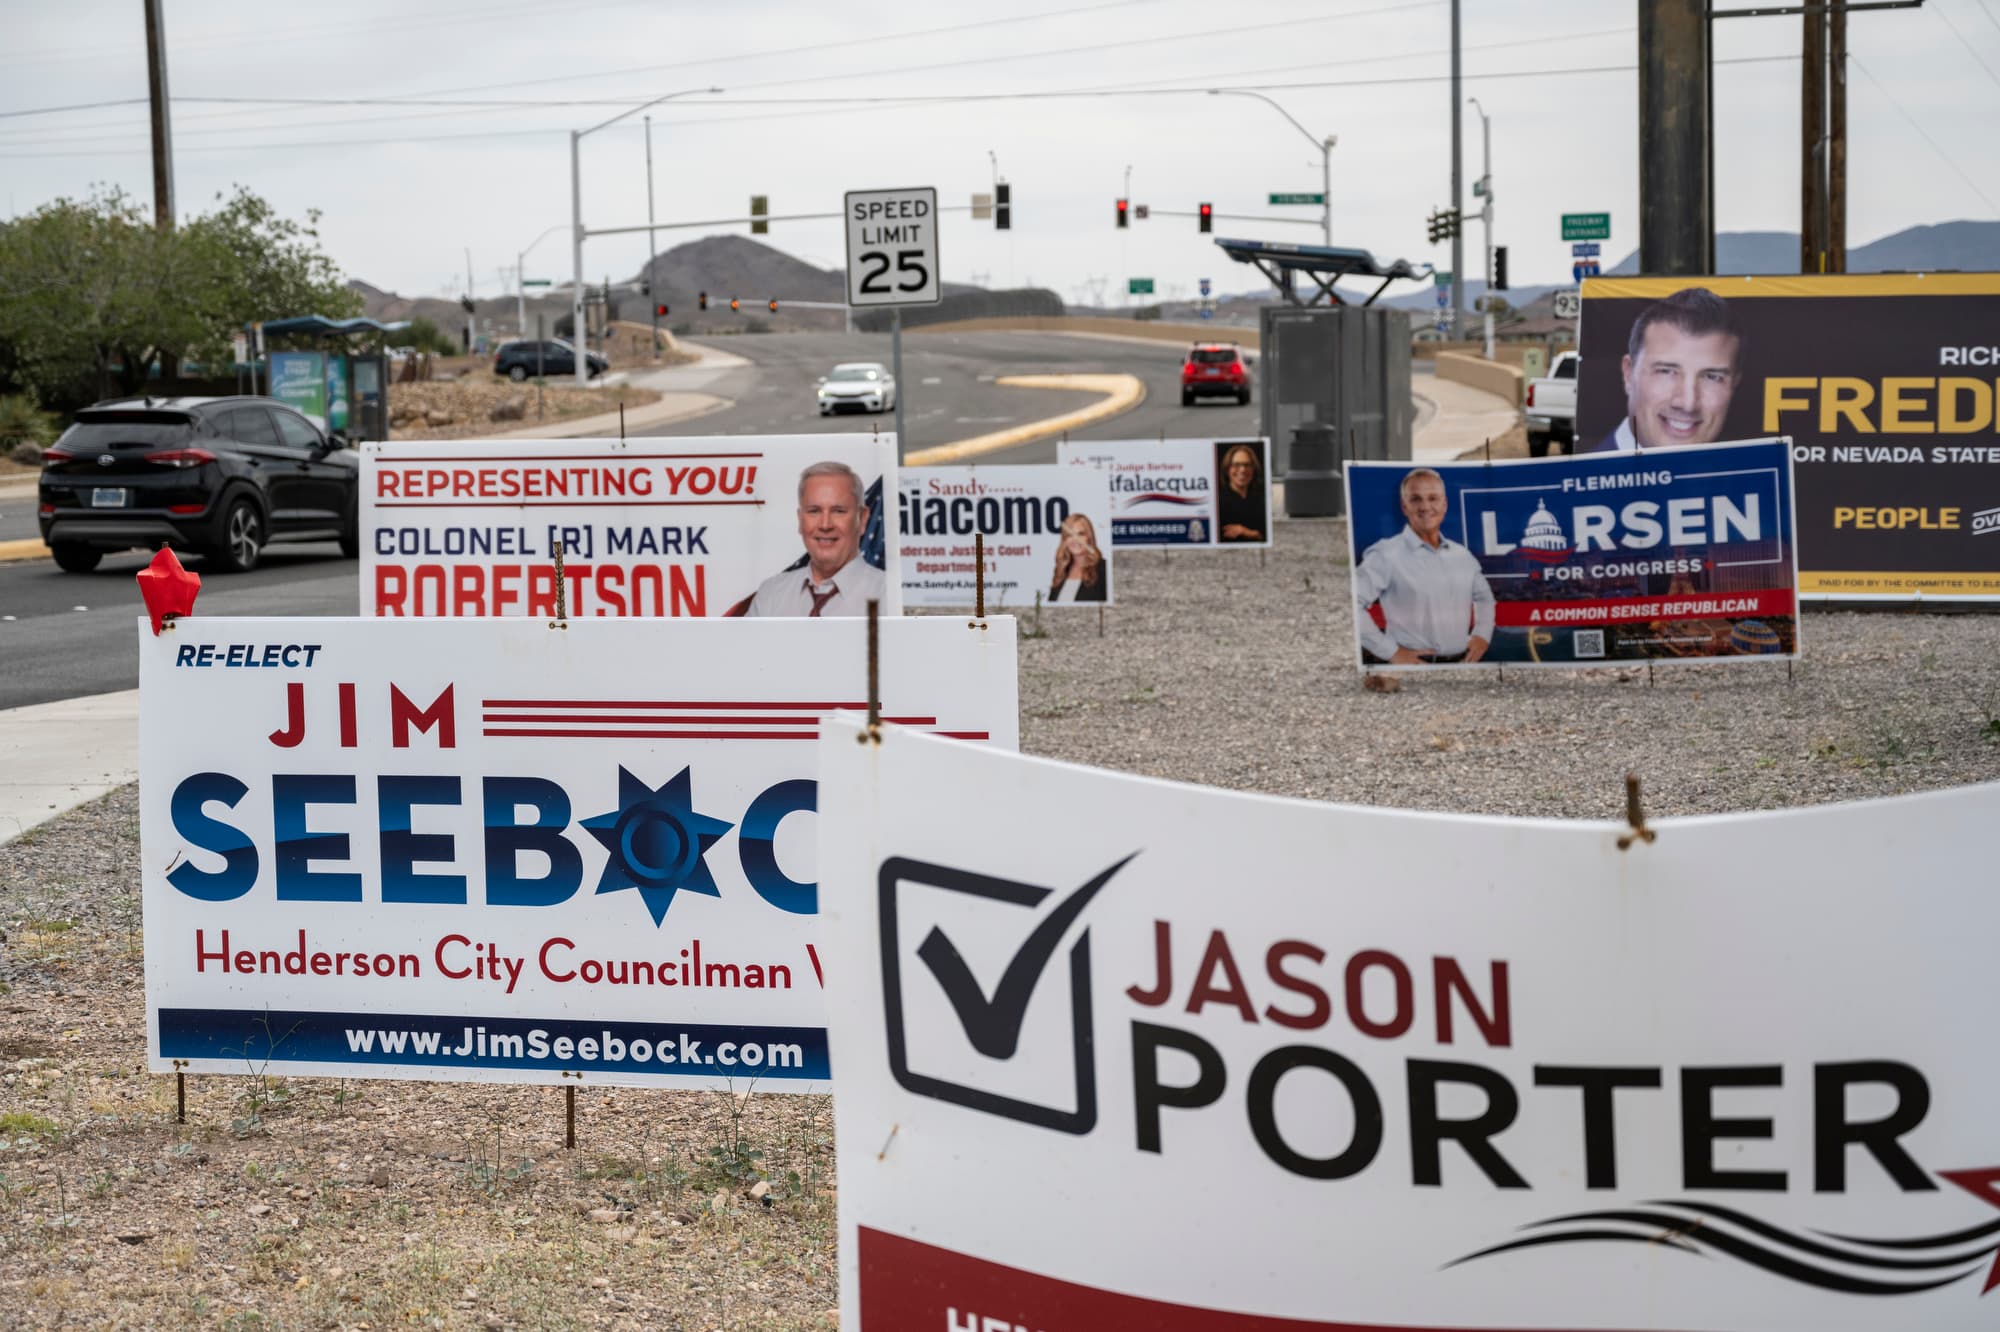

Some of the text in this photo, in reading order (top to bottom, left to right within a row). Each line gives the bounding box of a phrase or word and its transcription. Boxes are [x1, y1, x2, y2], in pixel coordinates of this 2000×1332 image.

[854, 200, 928, 221] SPEED
[862, 224, 921, 245] LIMIT
[858, 249, 928, 294] 25
[1558, 294, 1579, 314] 93
[1763, 376, 2000, 434] FRED
[1793, 446, 1826, 462] OR
[1832, 446, 1925, 464] NEVADA
[376, 465, 758, 498] REPRESENTING YOU!
[928, 477, 988, 499] Sandy
[1109, 473, 1210, 493] ifalacqua
[1562, 470, 1673, 493] FLEMMING
[1833, 506, 1961, 530] PEOPLE
[375, 525, 709, 559] COLONEL [R] MARK
[949, 545, 994, 557] Justce
[998, 544, 1031, 557] Court
[916, 562, 987, 575] Departmet
[1543, 559, 1702, 581] FOR CONGRESS
[375, 564, 707, 617] ROBERTSON
[1884, 580, 1902, 588] THE
[1530, 599, 1758, 621] A COMMON SENSE REPUBLICAN
[176, 644, 322, 668] RE-ELECT
[268, 682, 456, 748] JIM
[196, 928, 420, 977] Henderson
[435, 934, 525, 994] City
[538, 938, 792, 989] Councilman
[1124, 919, 1512, 1048] JASON
[345, 1026, 804, 1068] www.JimSeebock.com
[1130, 1020, 1942, 1194] PORTER
